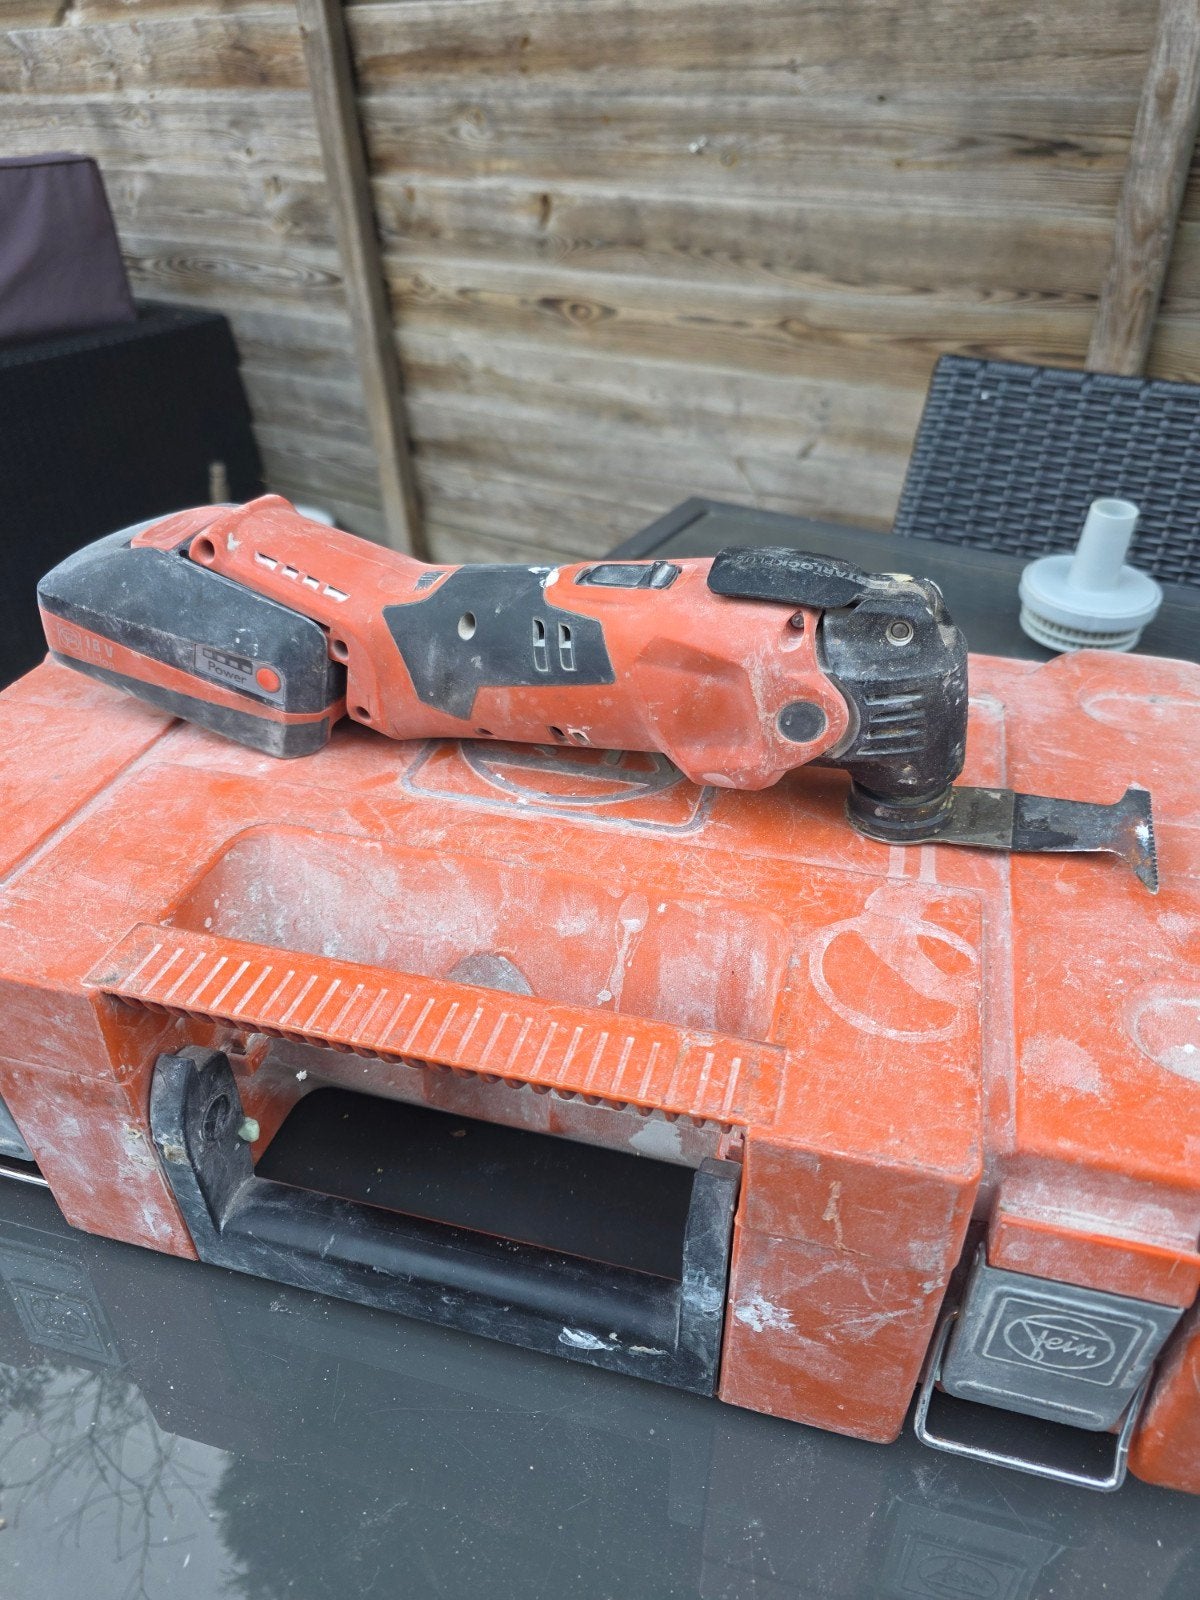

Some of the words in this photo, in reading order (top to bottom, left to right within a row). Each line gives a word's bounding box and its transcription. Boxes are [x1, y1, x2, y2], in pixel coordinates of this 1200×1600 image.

[84, 635, 101, 652] 18
[104, 643, 114, 658] V
[208, 660, 247, 685] Power
